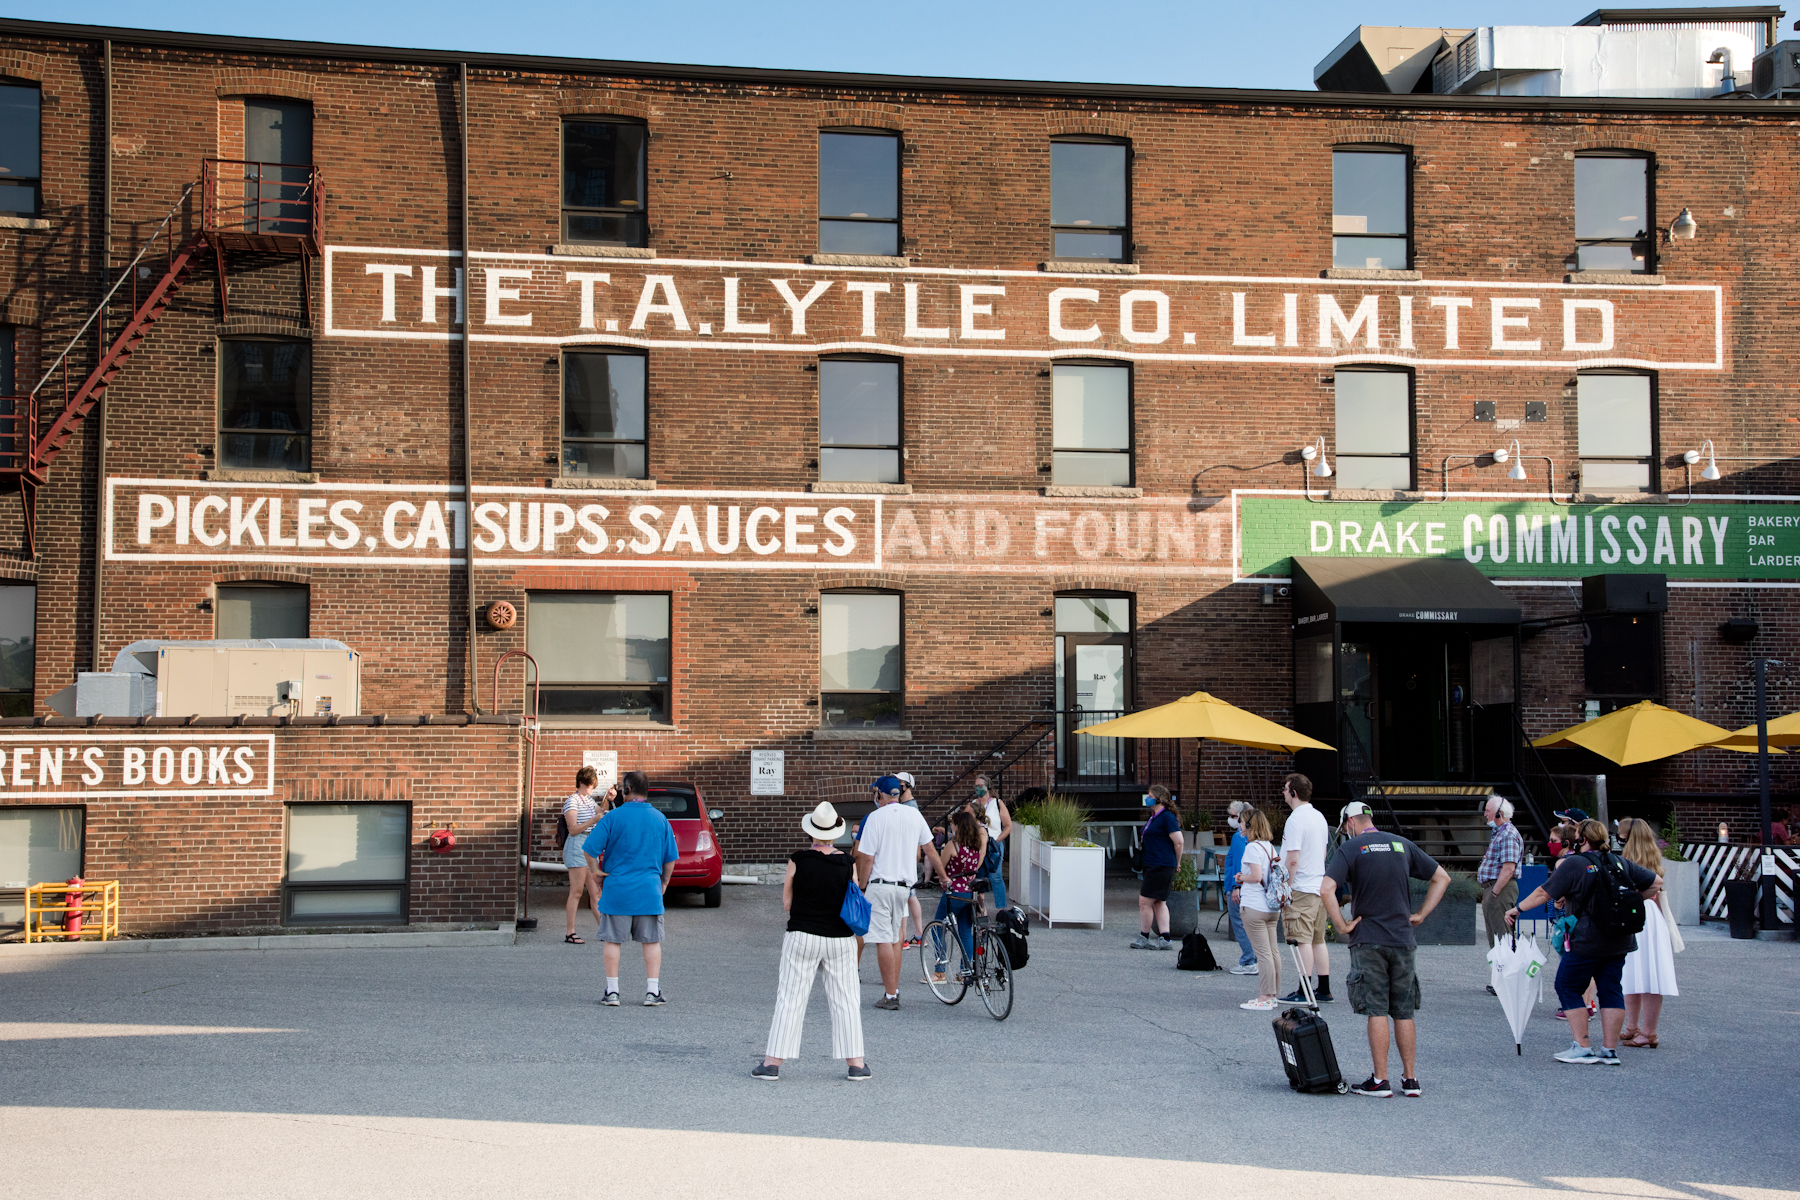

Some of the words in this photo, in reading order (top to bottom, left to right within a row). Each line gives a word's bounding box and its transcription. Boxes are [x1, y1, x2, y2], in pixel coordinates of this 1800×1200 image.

[365, 263, 533, 327] THE
[1048, 286, 1197, 345] CO.
[1231, 290, 1615, 351] LIMITED
[1748, 516, 1800, 527] BAKERY
[883, 508, 1011, 558] AND
[1035, 510, 1241, 560] FOUNT
[1310, 520, 1446, 553] DRAKE
[1463, 513, 1730, 566] COMMISSARY
[1748, 535, 1775, 546] BAR
[1749, 555, 1800, 566] LARDER
[1415, 611, 1458, 620] COMMISSARY
[1093, 673, 1107, 682] Ray
[0, 746, 105, 787] EN'S
[123, 746, 255, 786] BOOKS
[759, 766, 776, 777] Ray
[595, 768, 609, 778] ay
[1400, 786, 1418, 794] PLEASE
[1418, 786, 1435, 794] WATCH
[1435, 786, 1447, 794] YOUR
